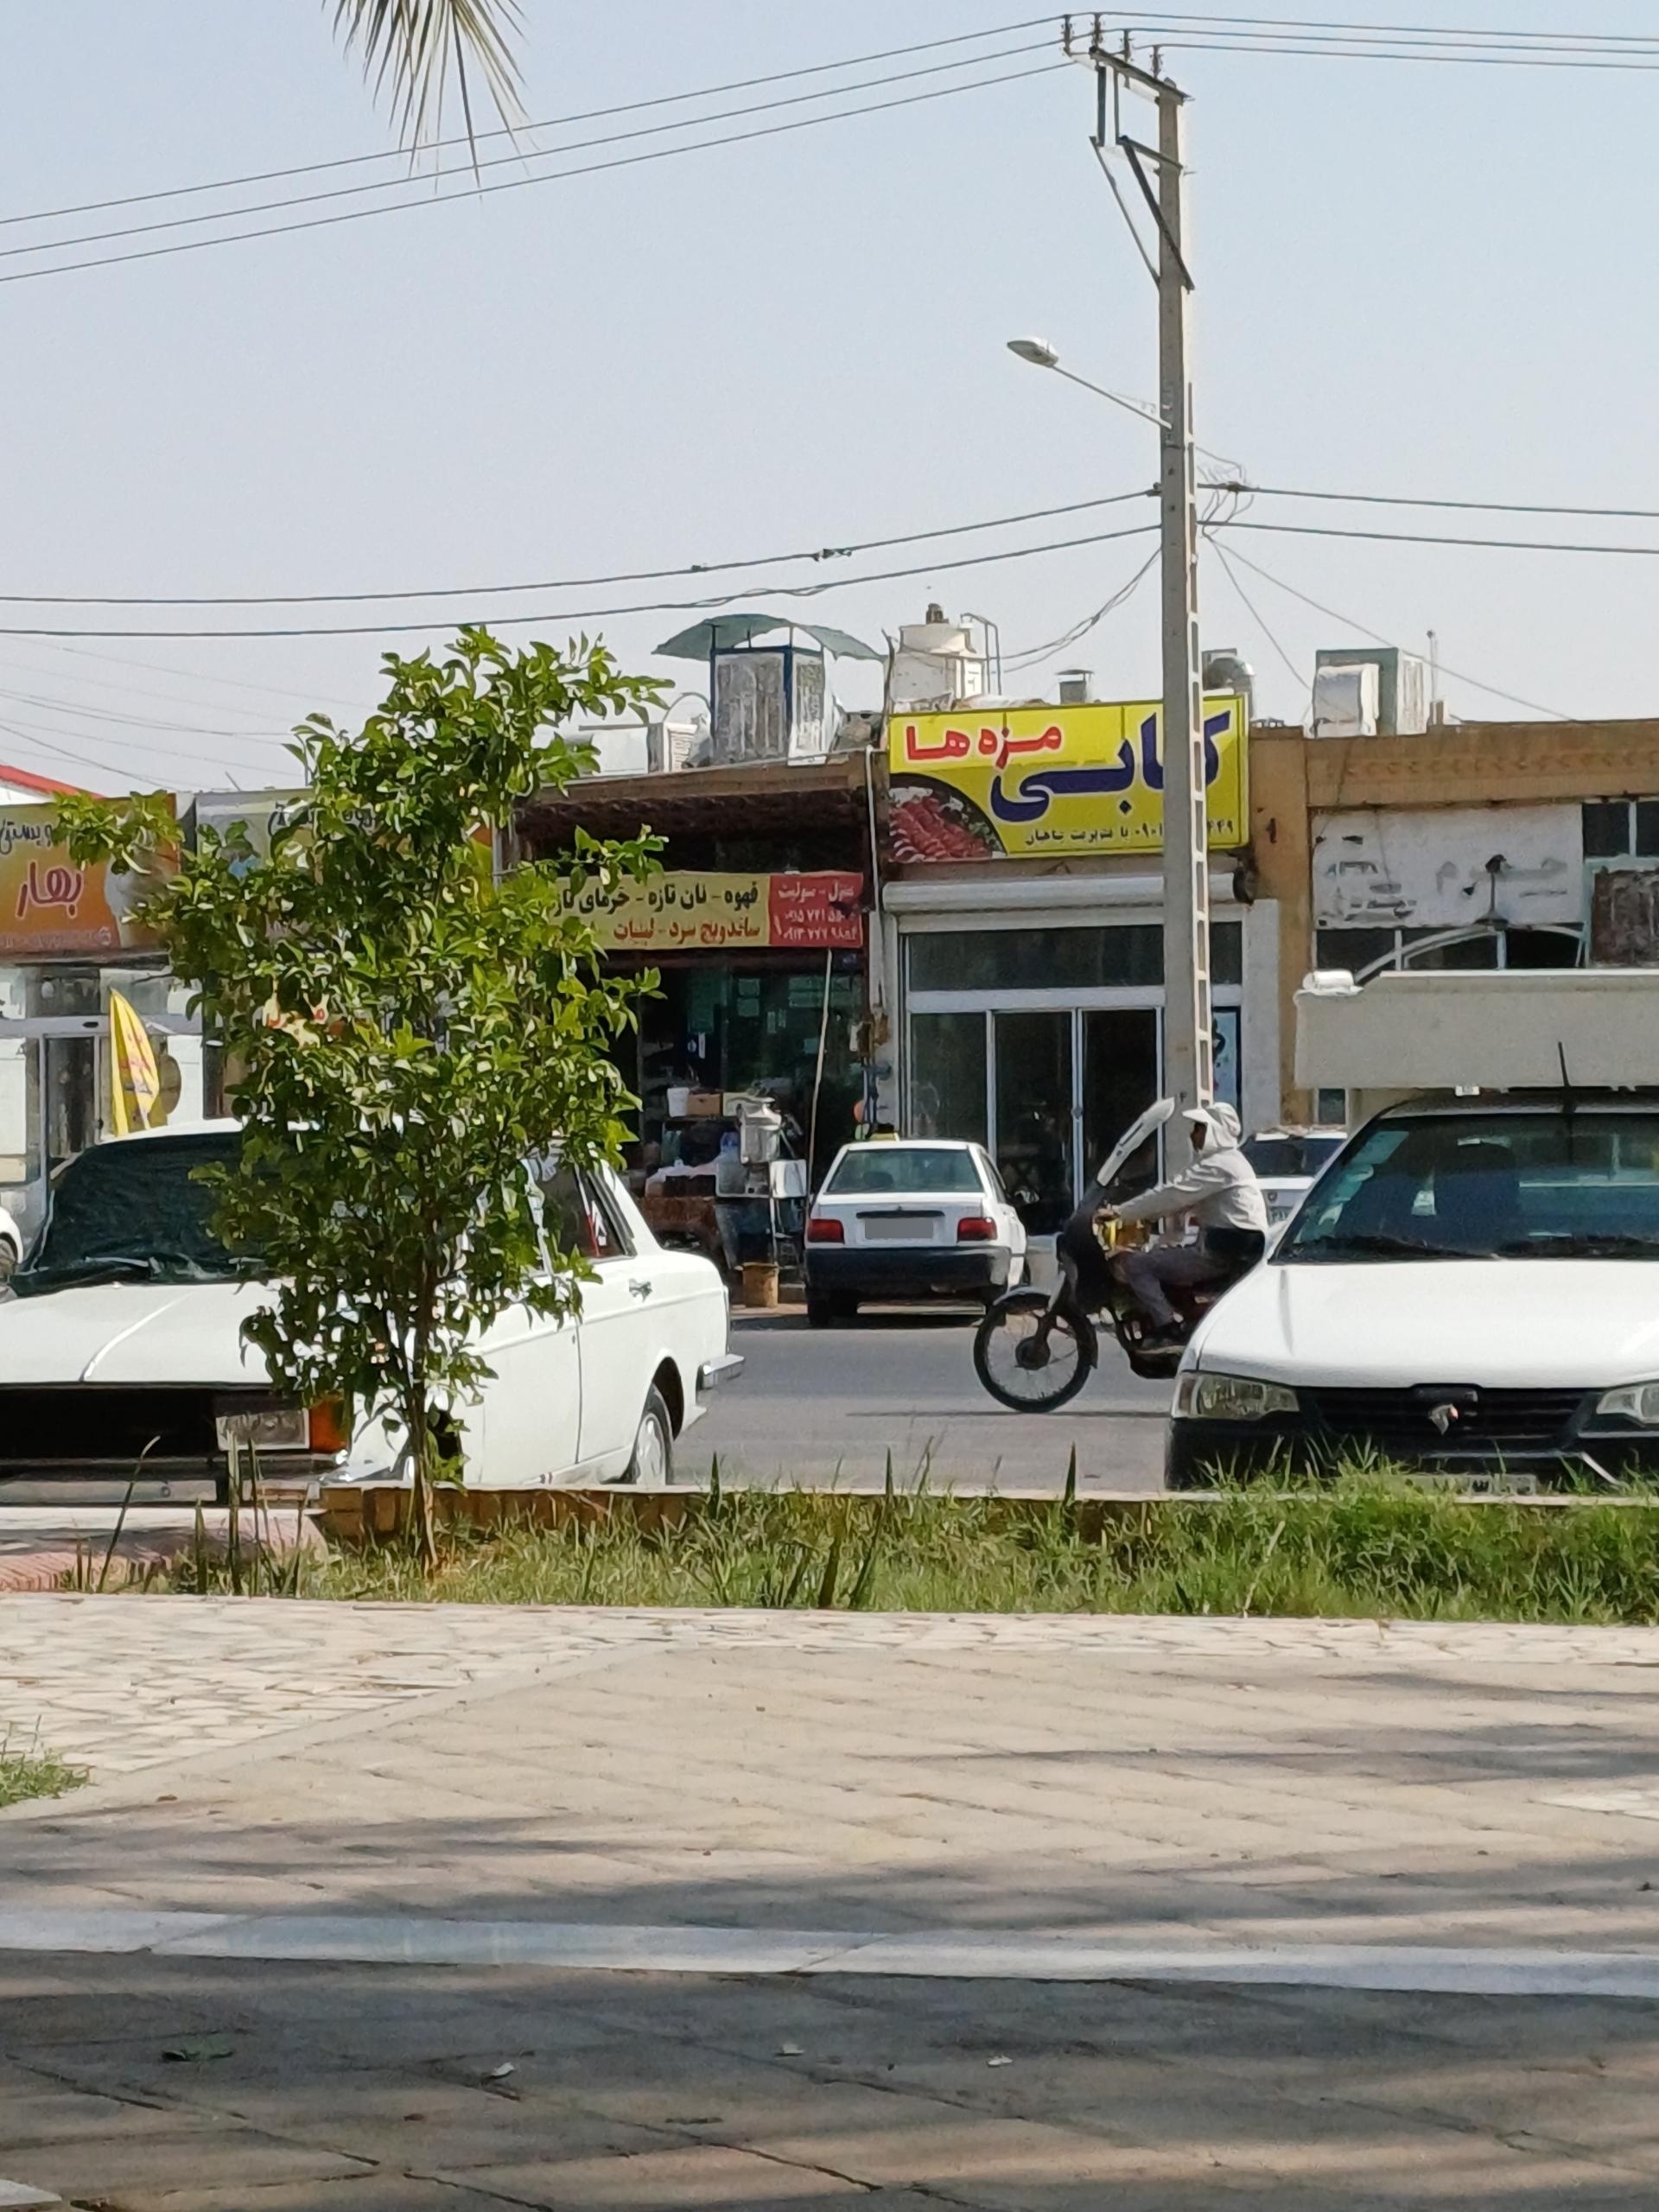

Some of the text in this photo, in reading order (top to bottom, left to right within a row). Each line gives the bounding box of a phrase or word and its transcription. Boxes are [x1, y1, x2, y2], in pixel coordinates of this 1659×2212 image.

[906, 725, 1062, 770] مزه ها
[16, 861, 82, 917] بهار
[579, 886, 630, 915] خرمای
[648, 883, 677, 912] تازه
[680, 883, 707, 911] نان
[724, 881, 759, 912] قهوه
[613, 917, 654, 946] لبنیات
[668, 921, 696, 944] سرد
